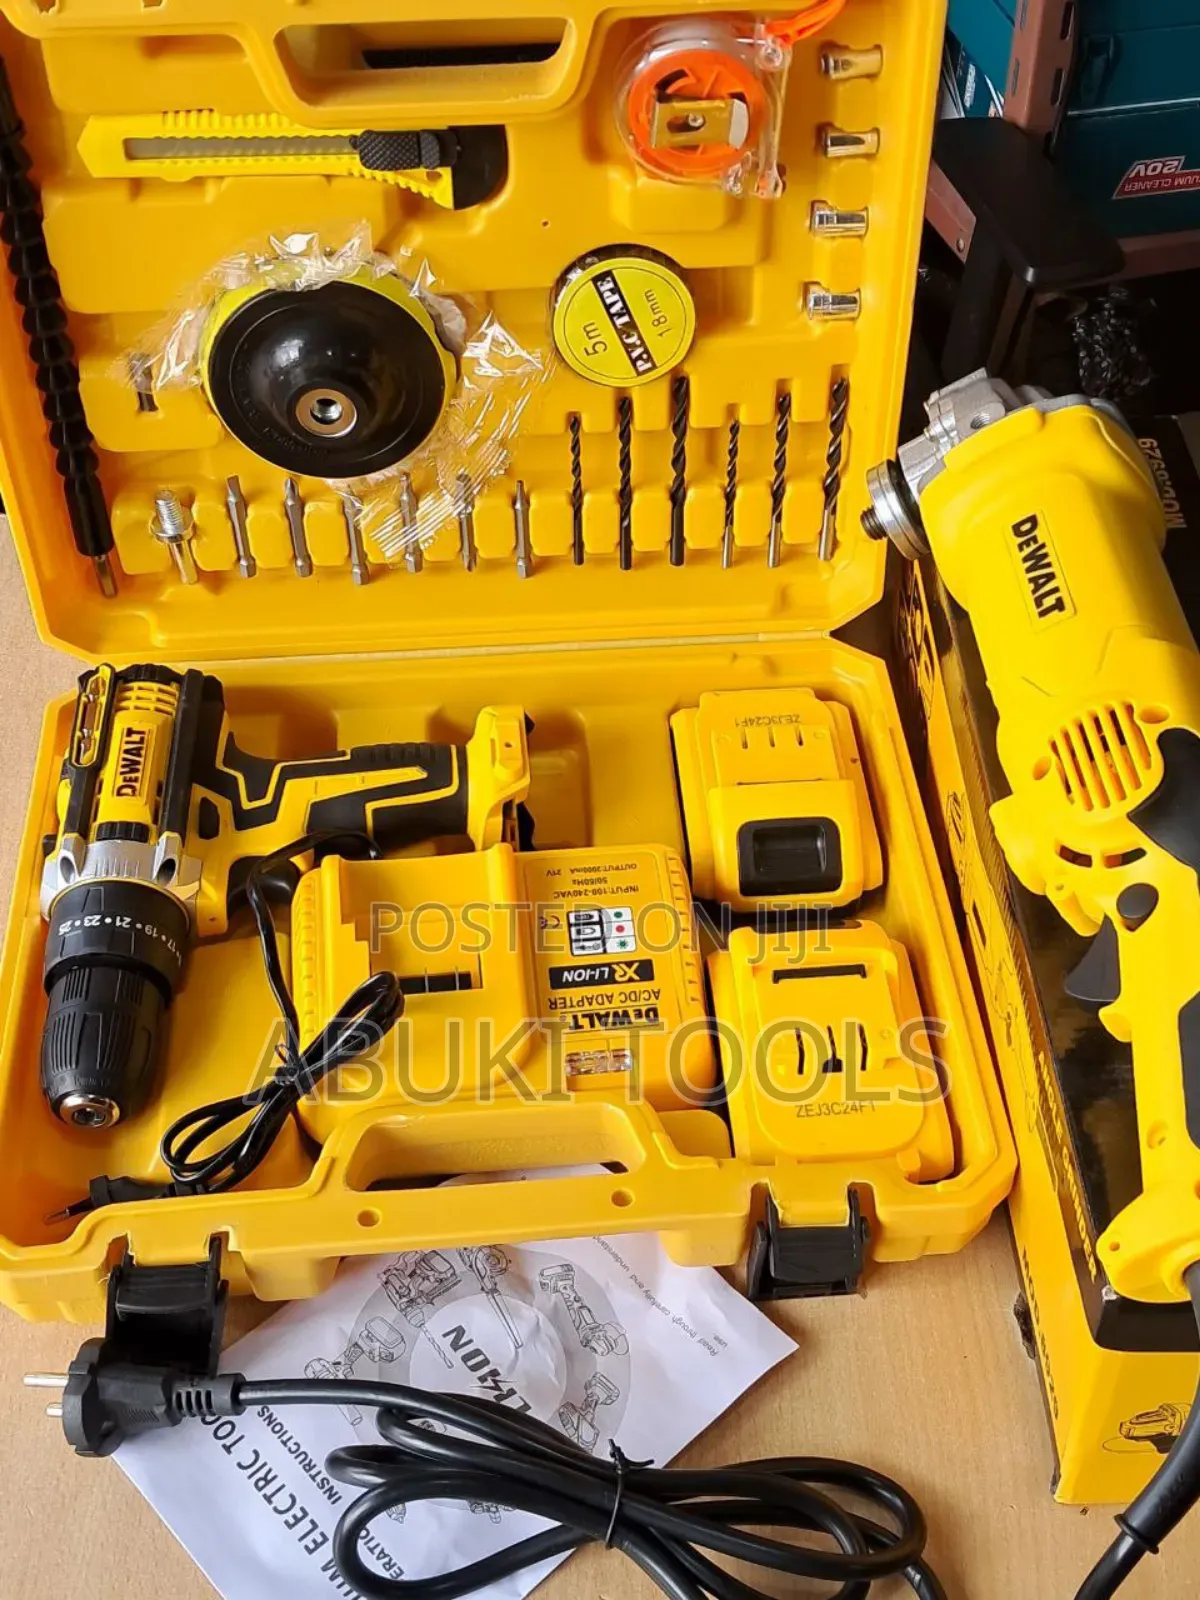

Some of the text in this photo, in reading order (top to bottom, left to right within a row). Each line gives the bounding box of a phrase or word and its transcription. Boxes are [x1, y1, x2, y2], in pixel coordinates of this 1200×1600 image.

[1129, 160, 1179, 178] 20V
[1125, 179, 1172, 191] CLEANER
[597, 276, 630, 329] TAPE
[644, 288, 672, 338] 18mm
[582, 322, 608, 357] 5m
[83, 914, 102, 927] 23
[115, 916, 132, 928] 21
[144, 924, 158, 937] 19
[562, 967, 610, 983] LI-ION
[548, 988, 661, 1010] AC/DC ADAPTER
[795, 1101, 876, 1118] ZEJ3C24F1
[630, 1274, 645, 1289] and
[643, 1289, 671, 1316] carefully
[671, 1315, 697, 1339] through
[697, 1338, 720, 1357] Read
[257, 1405, 343, 1505] INSTRUCTIONS
[236, 1449, 330, 1556] ELECTRIC
